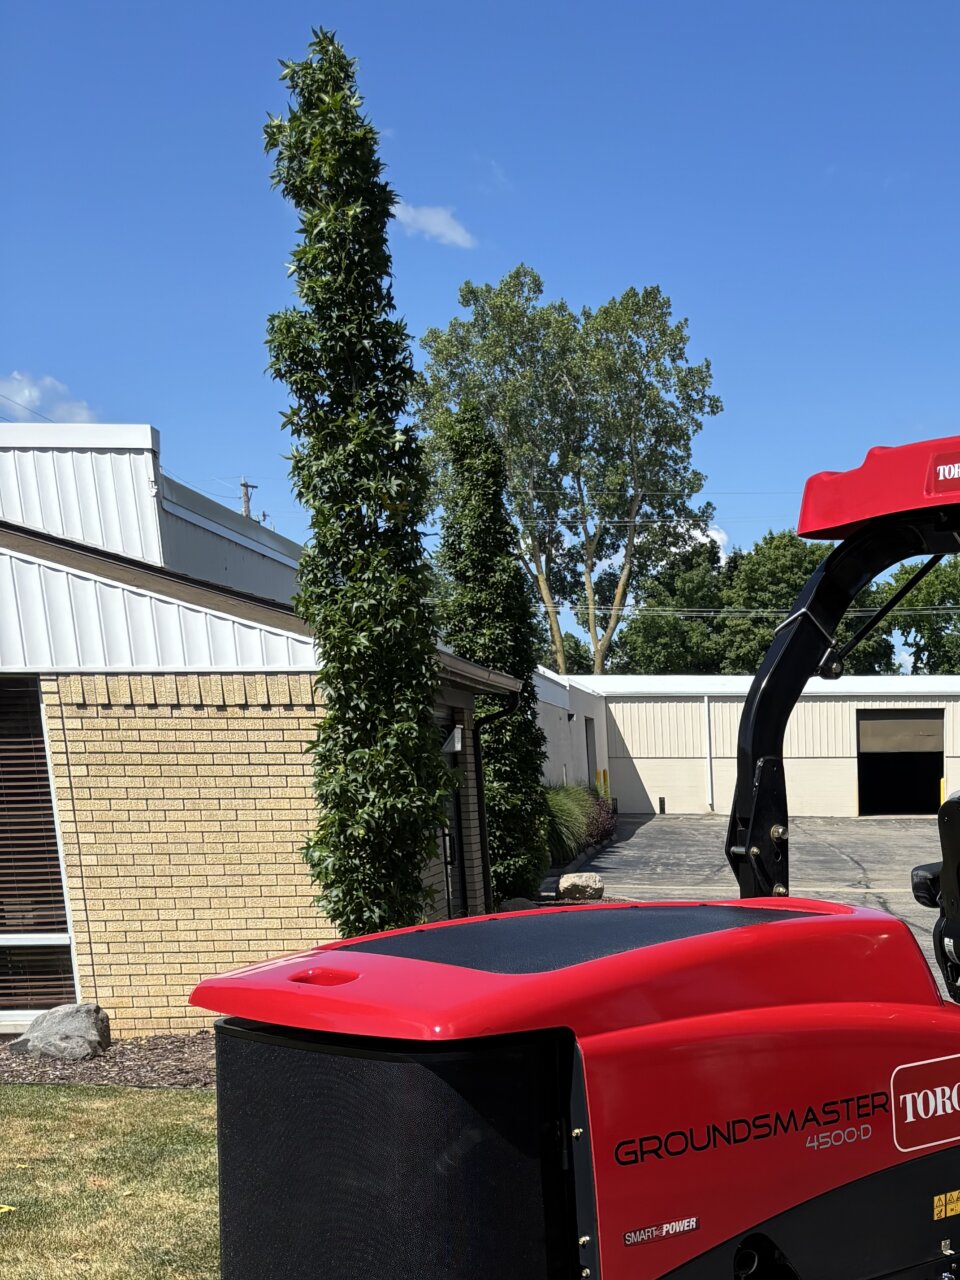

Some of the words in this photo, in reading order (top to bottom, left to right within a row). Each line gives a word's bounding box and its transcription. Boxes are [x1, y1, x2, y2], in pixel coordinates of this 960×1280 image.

[614, 1091, 889, 1166] GROUNDSMASTER
[625, 1227, 657, 1245] SMART
[662, 1217, 697, 1236] POWER
